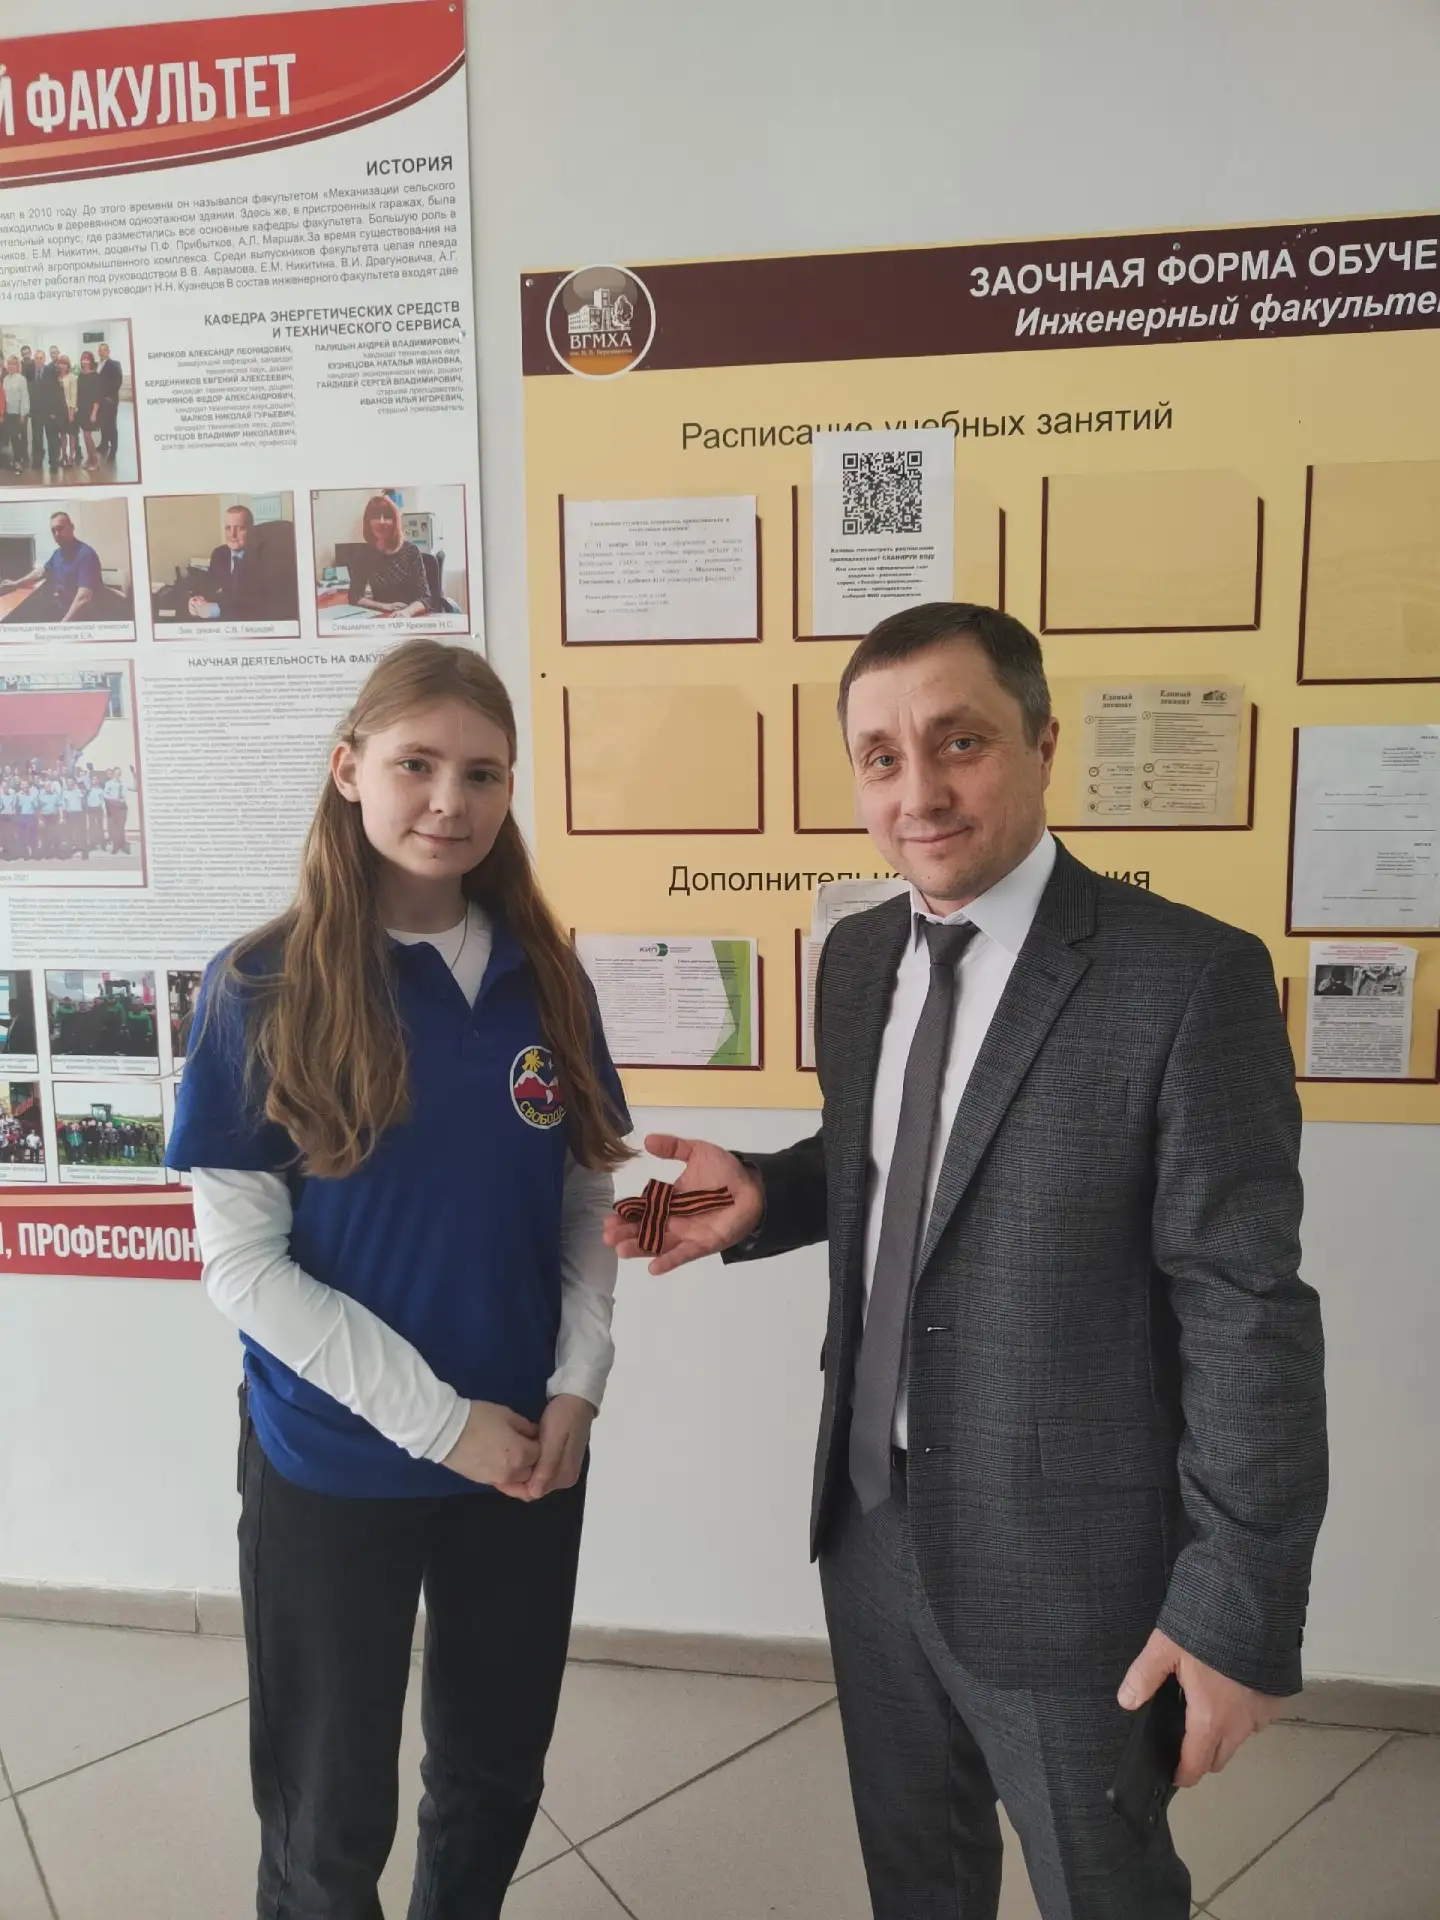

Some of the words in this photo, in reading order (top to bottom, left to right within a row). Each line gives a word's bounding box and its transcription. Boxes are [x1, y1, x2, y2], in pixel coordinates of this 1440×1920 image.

[27, 54, 296, 133] ФАКУЛЬТЕТ
[366, 156, 453, 176] ИСТОРИЯ
[28, 206, 52, 218] 2010
[82, 204, 96, 216] До
[100, 204, 126, 213] этого
[128, 201, 173, 213] времени
[176, 200, 189, 208] он
[192, 196, 248, 207] назывался
[250, 191, 318, 205] факультетом
[322, 186, 398, 199] «Механизации
[402, 182, 456, 193] сельского
[64, 217, 126, 231] деревянном
[128, 213, 196, 226] одноэтажном
[240, 207, 270, 219] Здесь
[301, 201, 376, 215] пристроенных
[428, 195, 456, 205] была
[86, 233, 102, 243] где
[104, 228, 176, 242] разместились
[178, 227, 196, 235] все
[198, 223, 248, 234] основные
[252, 219, 299, 232] кафедры
[368, 212, 418, 223] Большую
[420, 210, 446, 222] роль
[104, 244, 146, 256] доценты
[323, 230, 356, 241] время
[358, 225, 440, 239] существования
[444, 224, 456, 232] на
[47, 257, 150, 272] агропромышленного
[213, 250, 246, 262] Среди
[250, 247, 315, 259] выпускников
[319, 243, 378, 256] факультета
[382, 241, 414, 252] целая
[418, 238, 457, 248] плеяда
[44, 274, 84, 287] работал
[88, 274, 106, 284] под
[108, 269, 177, 283] руководством
[969, 257, 1145, 298] ЗАОЧНАЯ
[1158, 248, 1297, 286] ФОРМА
[1308, 238, 1438, 276] ОБУЧЕ
[14, 291, 34, 301] года
[37, 287, 100, 300] факультетом
[102, 284, 152, 296] руководит
[178, 280, 224, 292] Кузнецов
[226, 277, 234, 287] В
[235, 277, 269, 286] состав
[271, 273, 338, 284] инженерного
[340, 269, 400, 282] факультета
[401, 267, 436, 278] входят
[438, 266, 458, 277] две
[204, 312, 266, 326] КАФЕДРА
[270, 304, 392, 323] ЭНЕРГЕТИЧЕСКИХ
[396, 301, 460, 316] СРЕДСТВ
[1014, 295, 1240, 337] Инженерный
[1250, 290, 1440, 335] факульте
[272, 327, 281, 339] И
[285, 321, 392, 336] ТЕХНИЧЕСКОГО
[396, 318, 462, 332] СЕРВИСА
[357, 339, 390, 350] АНДРЕЙ
[570, 332, 632, 350] ВГМХА
[146, 350, 186, 359] БИРЮКОВ
[188, 348, 234, 358] АЛЕКСАНДР
[328, 360, 374, 370] КУЗНЕЦОВА
[376, 358, 414, 367] НАТАЛЬЯ
[144, 378, 201, 388] БЕРДЕННИКОВ
[202, 375, 238, 385] ЕВГЕНИЙ
[360, 377, 392, 387] СЕРГЕЙ
[360, 397, 393, 406] ИВАНОВ
[394, 396, 418, 404] ИЛЬЯ
[180, 414, 212, 422] МАЛКОВ
[214, 411, 252, 421] НИКОЛАЙ
[1036, 401, 1174, 436] занятий
[154, 433, 196, 442] ОСТРЕЦОВ
[197, 431, 240, 440] ВЛАДИМИР
[188, 656, 238, 666] НАУЧНАЯ
[240, 654, 328, 666] ДЕЯТЕЛЬНОСТЬ
[330, 653, 346, 663] НА
[18, 1222, 201, 1262] ПРОФЕССИОН
